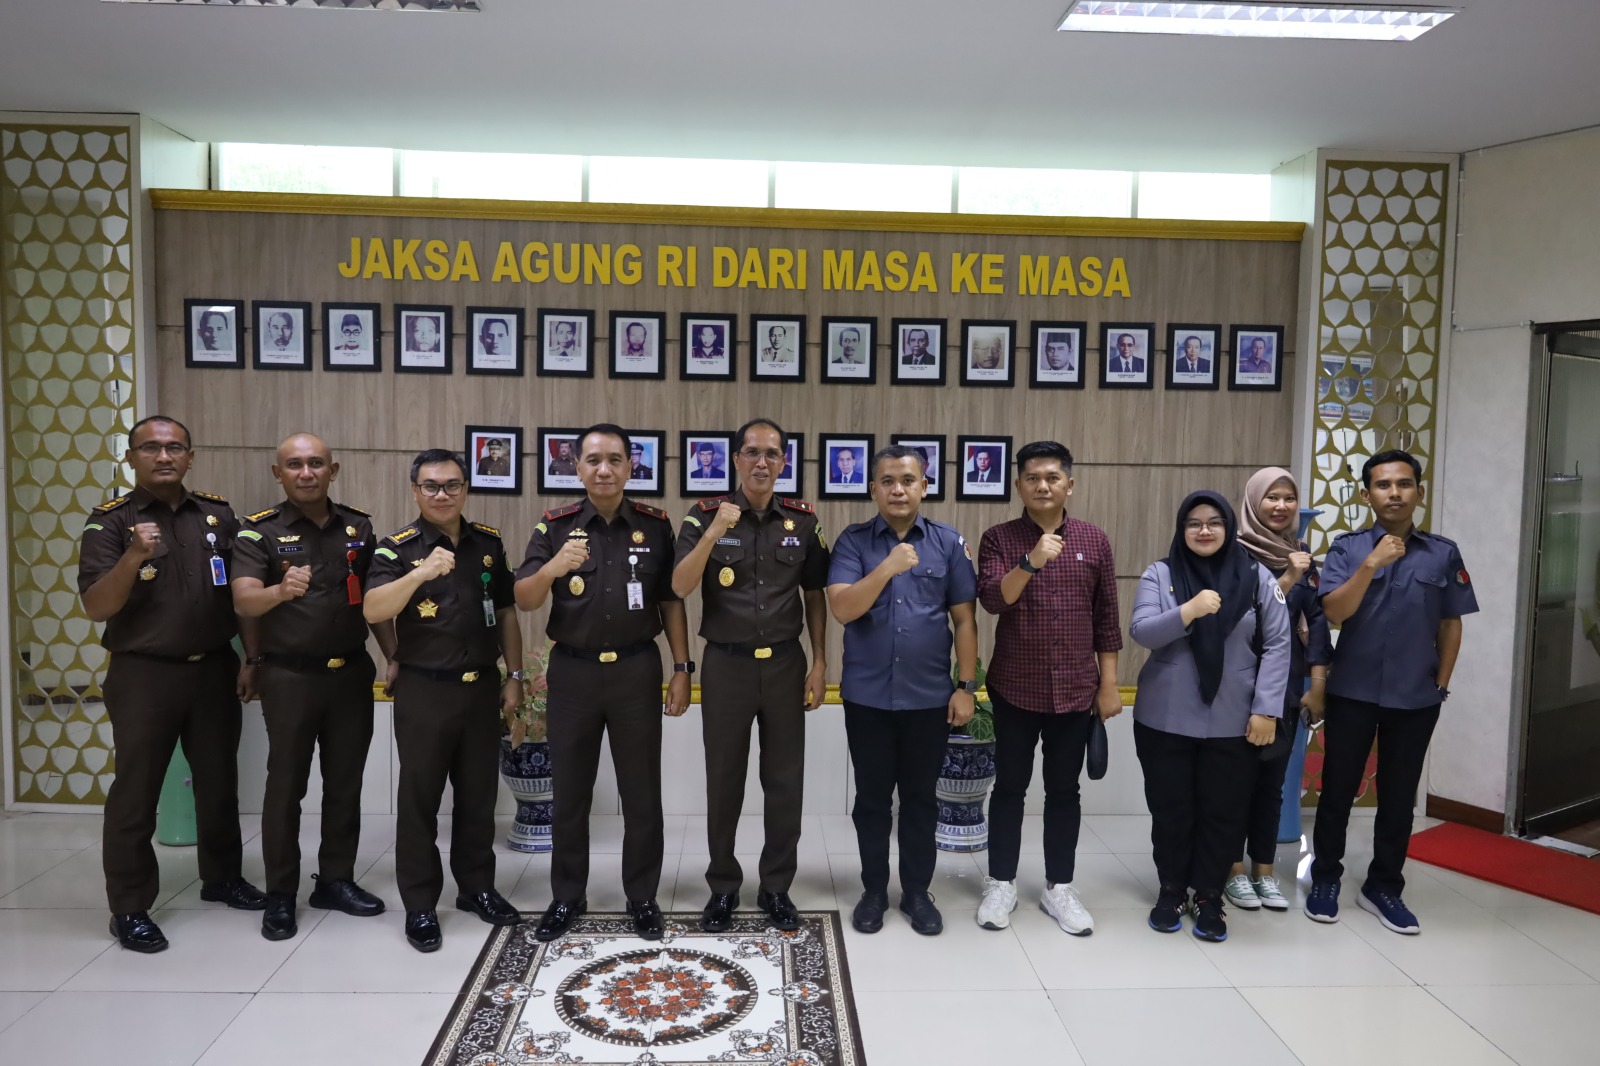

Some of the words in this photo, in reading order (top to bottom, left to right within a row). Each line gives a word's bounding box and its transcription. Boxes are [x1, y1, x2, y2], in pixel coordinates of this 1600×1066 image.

[338, 237, 481, 281] JAKSA
[492, 242, 643, 286] AGUNG
[657, 245, 698, 288] RI
[712, 246, 808, 290] DARI
[822, 248, 938, 293] MASA
[951, 252, 1005, 295] KE
[1018, 255, 1132, 298] MASA
